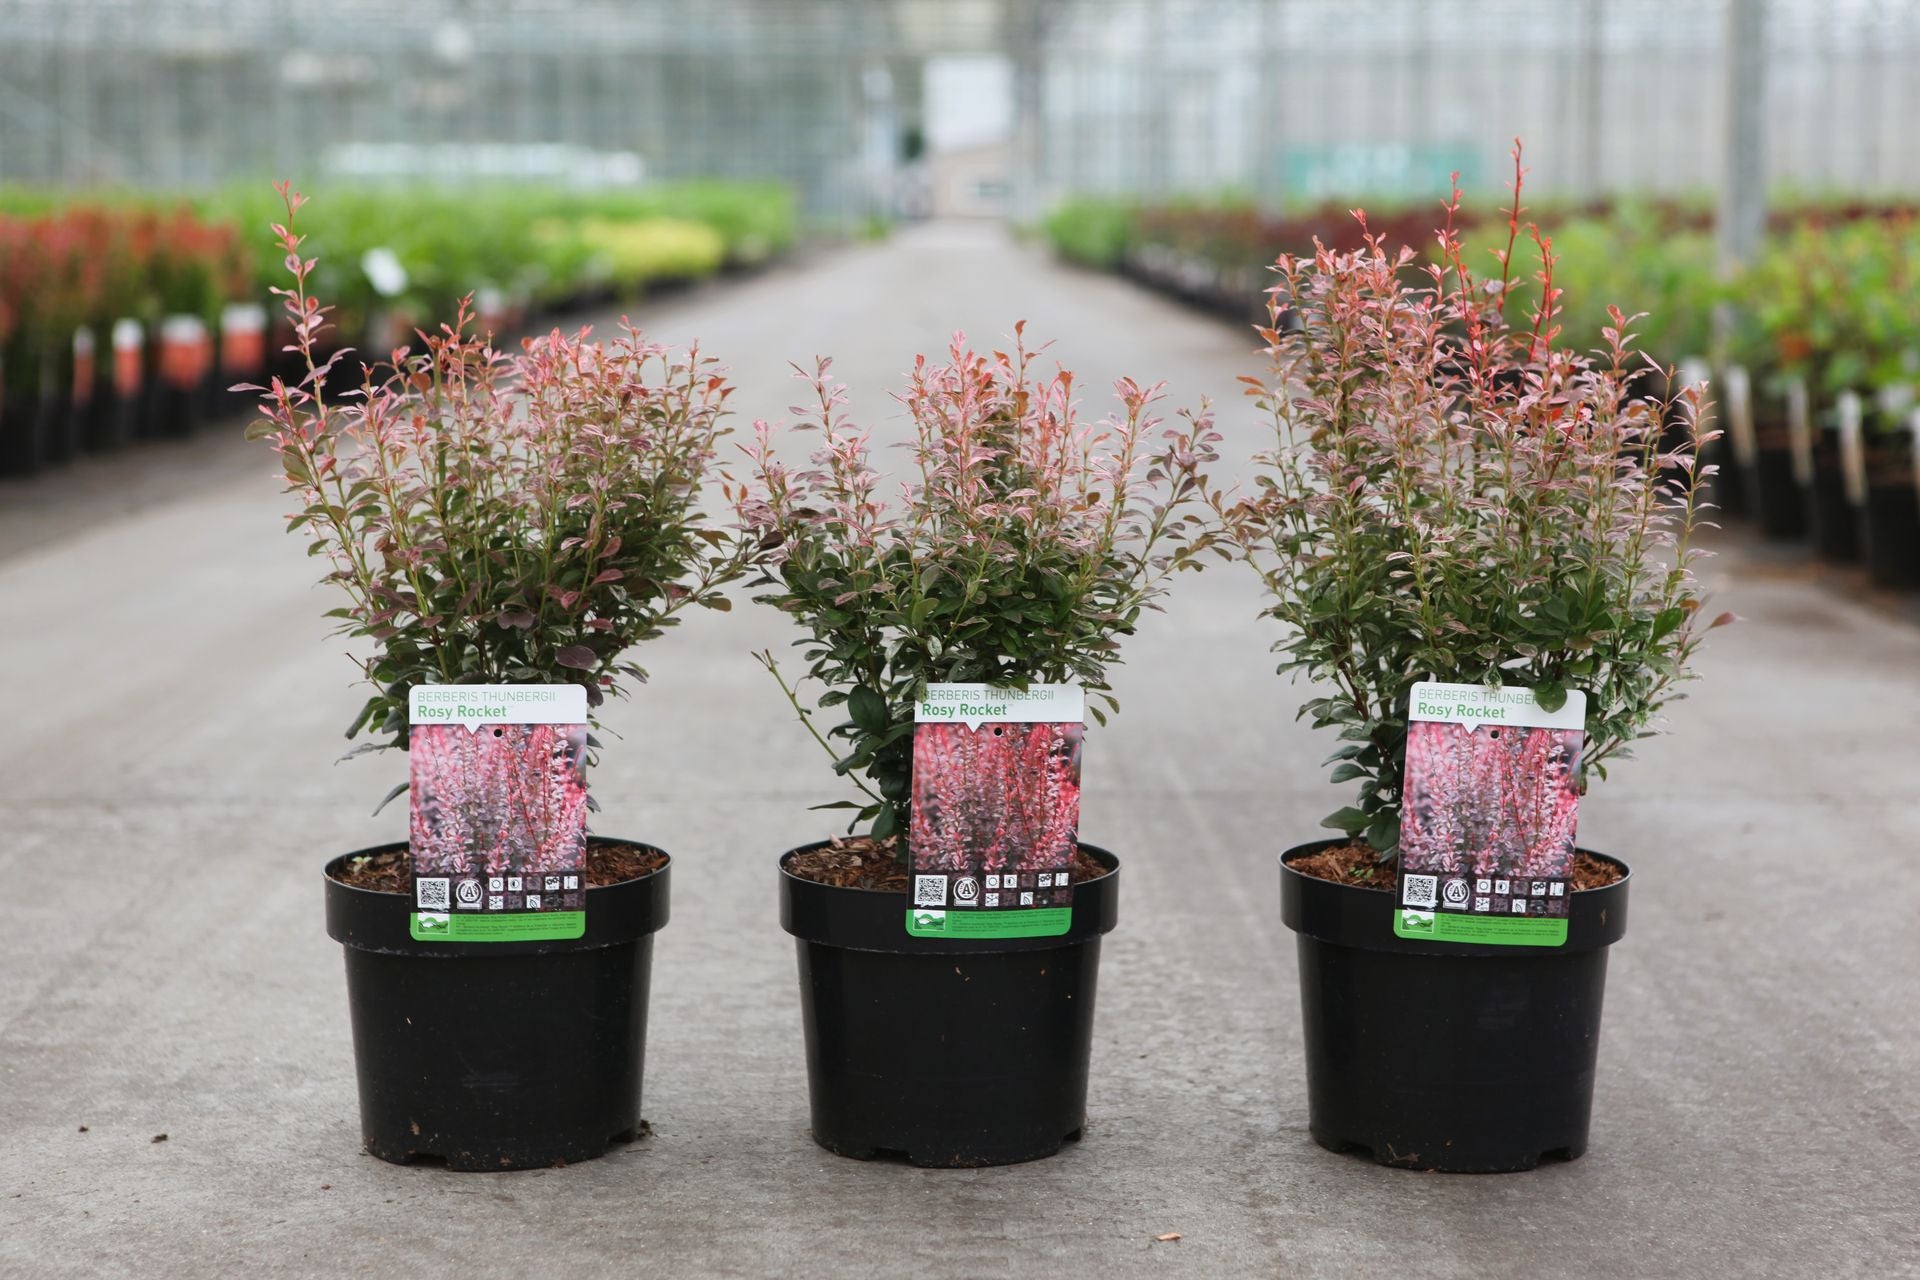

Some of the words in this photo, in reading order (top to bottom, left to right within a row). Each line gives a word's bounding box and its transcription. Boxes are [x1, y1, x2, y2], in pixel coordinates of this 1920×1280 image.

[418, 691, 479, 702] BERBERIS
[481, 691, 556, 702] THUNBERGII
[984, 689, 1055, 701] THUNBERGII
[1418, 688, 1479, 702] BERBERIS
[418, 705, 452, 720] Rosy
[457, 705, 507, 717] Rocket
[922, 703, 955, 718] Rosy
[960, 703, 1007, 716] Rocket
[1418, 702, 1452, 719] Rosy
[1456, 703, 1506, 719] Rocket
